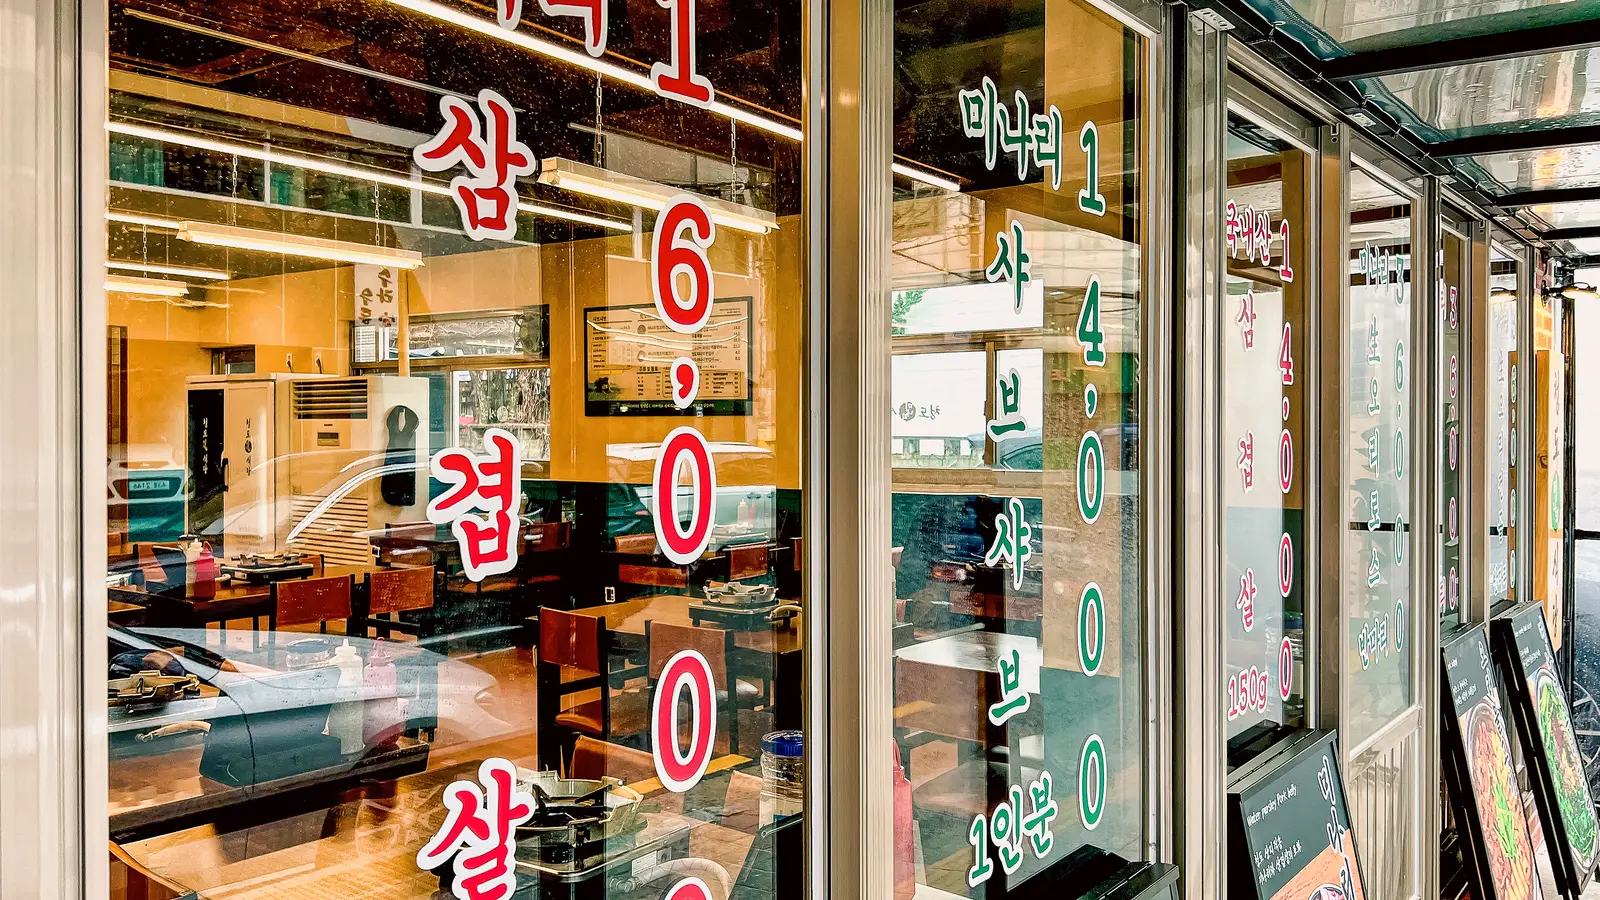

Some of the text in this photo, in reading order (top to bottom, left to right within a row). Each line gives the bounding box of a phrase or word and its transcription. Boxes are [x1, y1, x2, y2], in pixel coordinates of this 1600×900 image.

[961, 79, 1061, 187] 미나리
[1227, 201, 1271, 263] 국내산
[1360, 242, 1389, 294] 미나리
[417, 92, 534, 900] 삼겹살
[651, 0, 716, 900] 16,00
[987, 223, 1031, 724] 샤브샤브
[1078, 123, 1106, 828] 14,000
[1238, 291, 1256, 630] 삼겹살
[1279, 220, 1292, 699] 14,000
[1396, 255, 1404, 651] 36,000
[1228, 666, 1267, 719] 150g
[1359, 614, 1389, 670] 반마리
[968, 773, 1057, 885] 1인분
